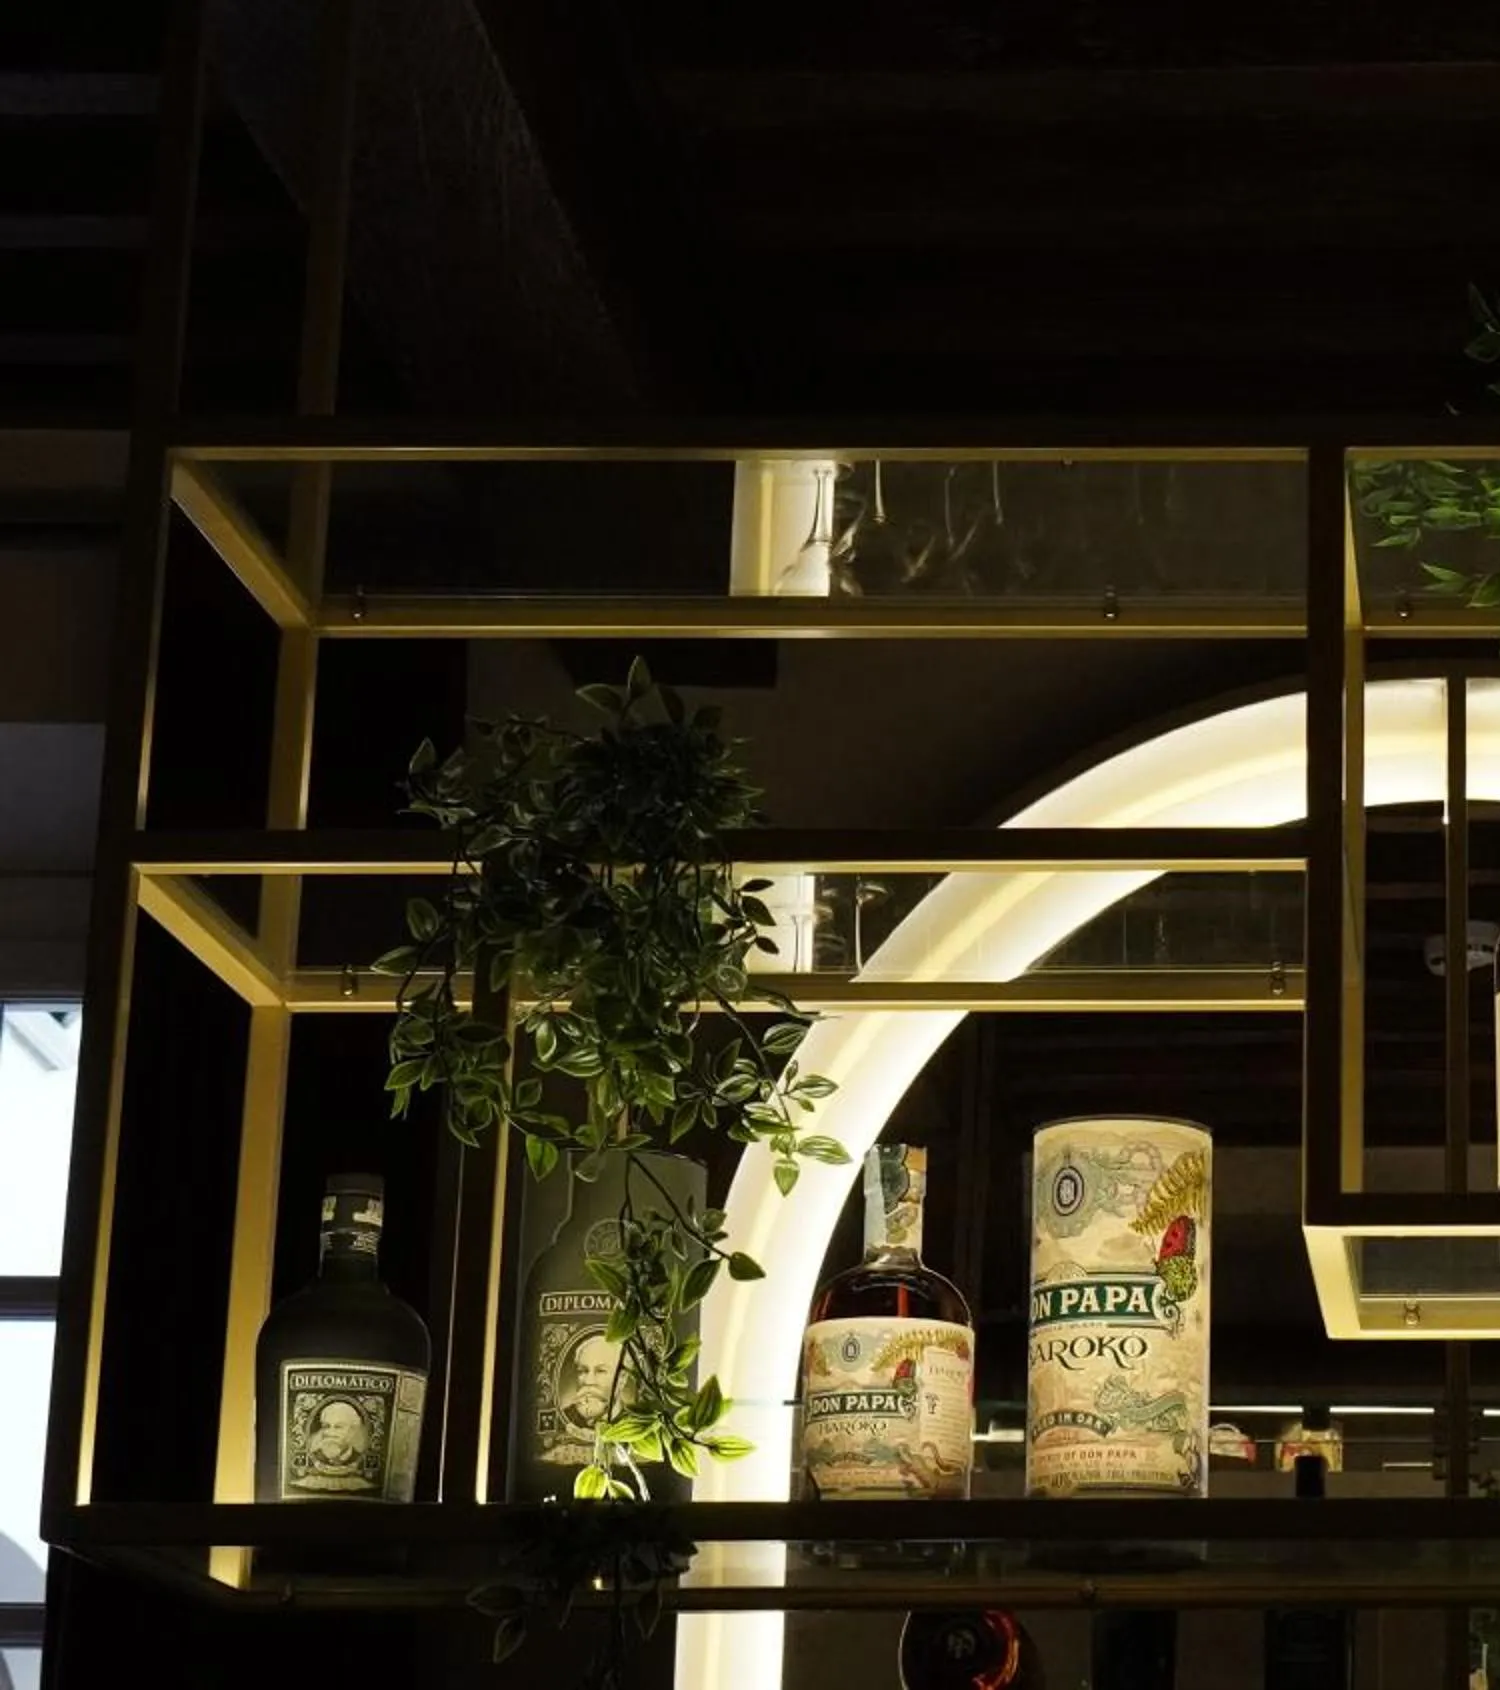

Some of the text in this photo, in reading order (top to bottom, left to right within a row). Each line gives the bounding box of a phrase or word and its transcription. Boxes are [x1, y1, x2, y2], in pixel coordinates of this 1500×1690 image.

[545, 1295, 625, 1312] DIPLOMA
[1031, 1285, 1150, 1323] ON PAPA
[1030, 1335, 1148, 1370] AROKO
[813, 1395, 897, 1413] DON PAPA
